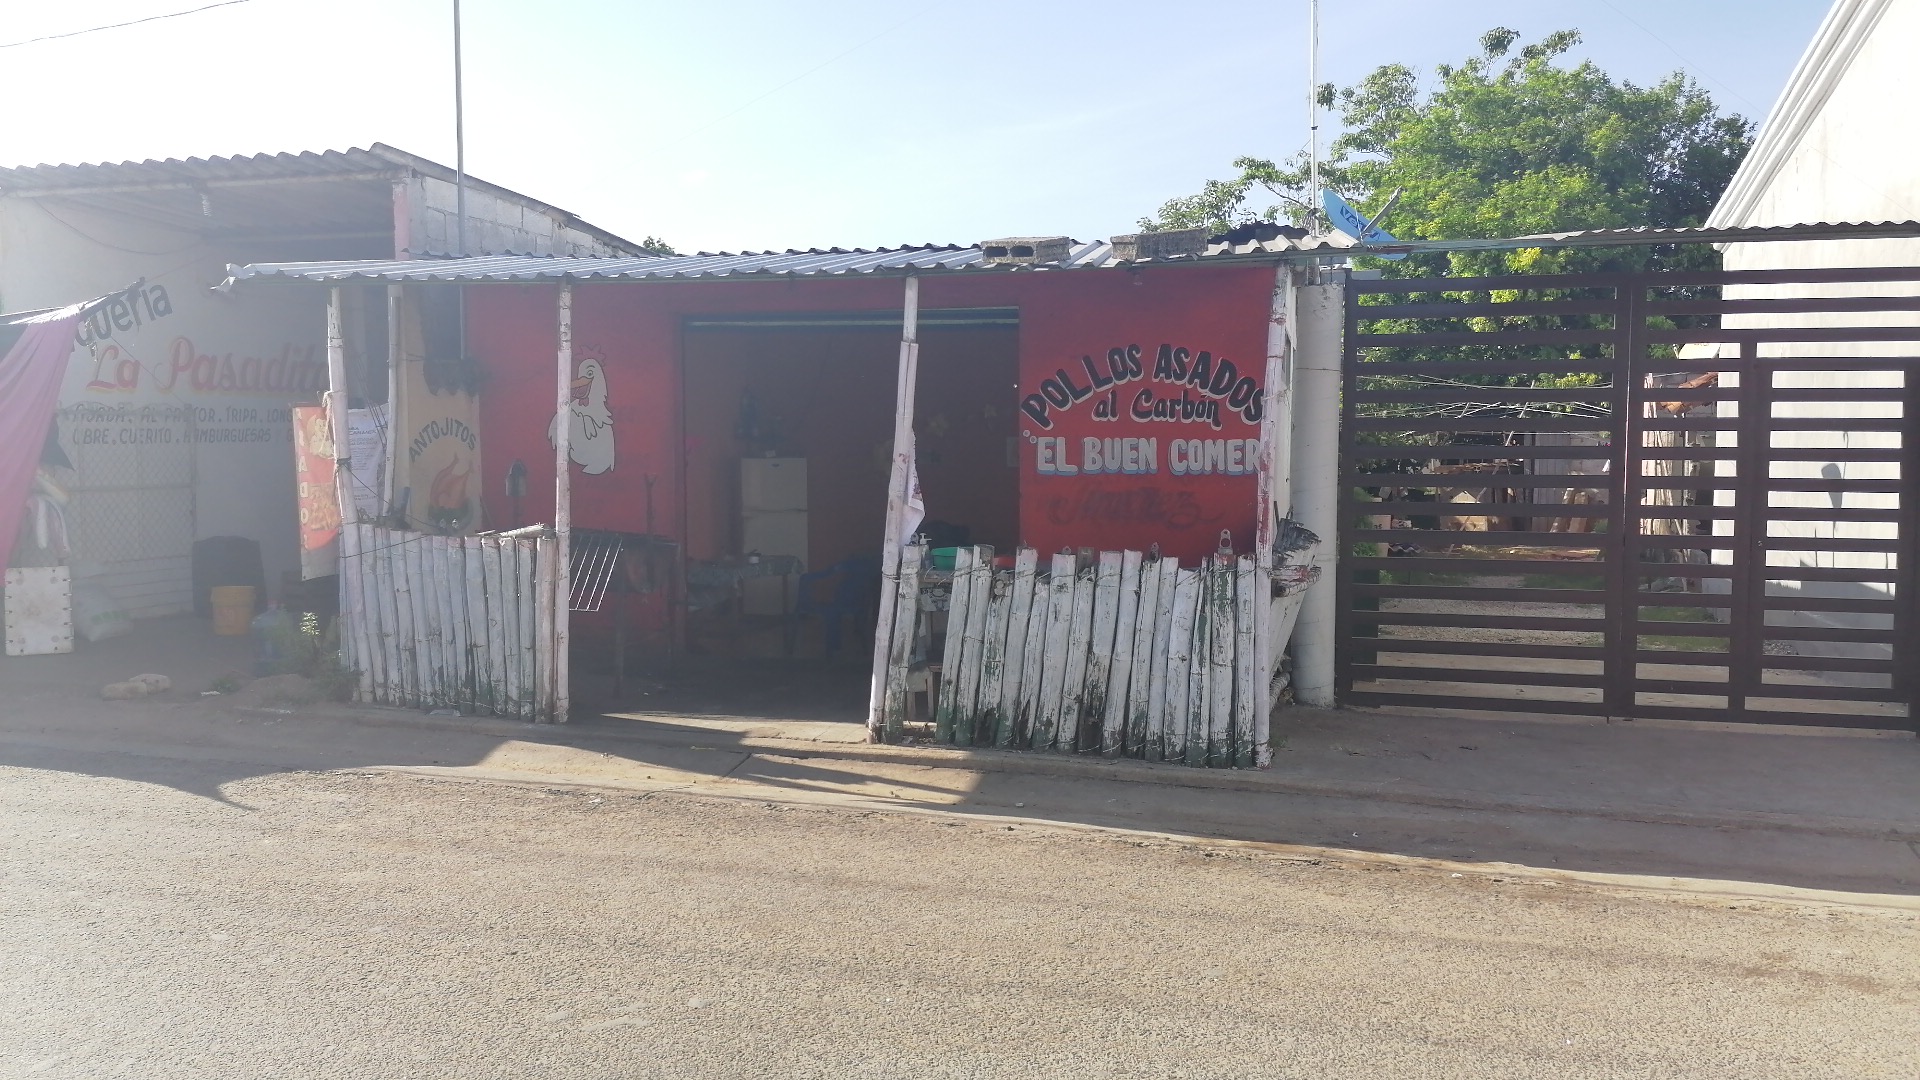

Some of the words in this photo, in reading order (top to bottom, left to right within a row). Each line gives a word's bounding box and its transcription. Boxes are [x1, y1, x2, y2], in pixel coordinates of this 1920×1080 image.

[86, 345, 141, 391] La
[1020, 343, 1144, 431] POLLOS
[1152, 343, 1265, 425] ASADOS
[1092, 388, 1120, 421] al
[1130, 387, 1223, 431] Carbón
[408, 416, 477, 464] ANTOJITOS
[1082, 436, 1159, 476] BUEN
[1168, 437, 1261, 476] COMER
